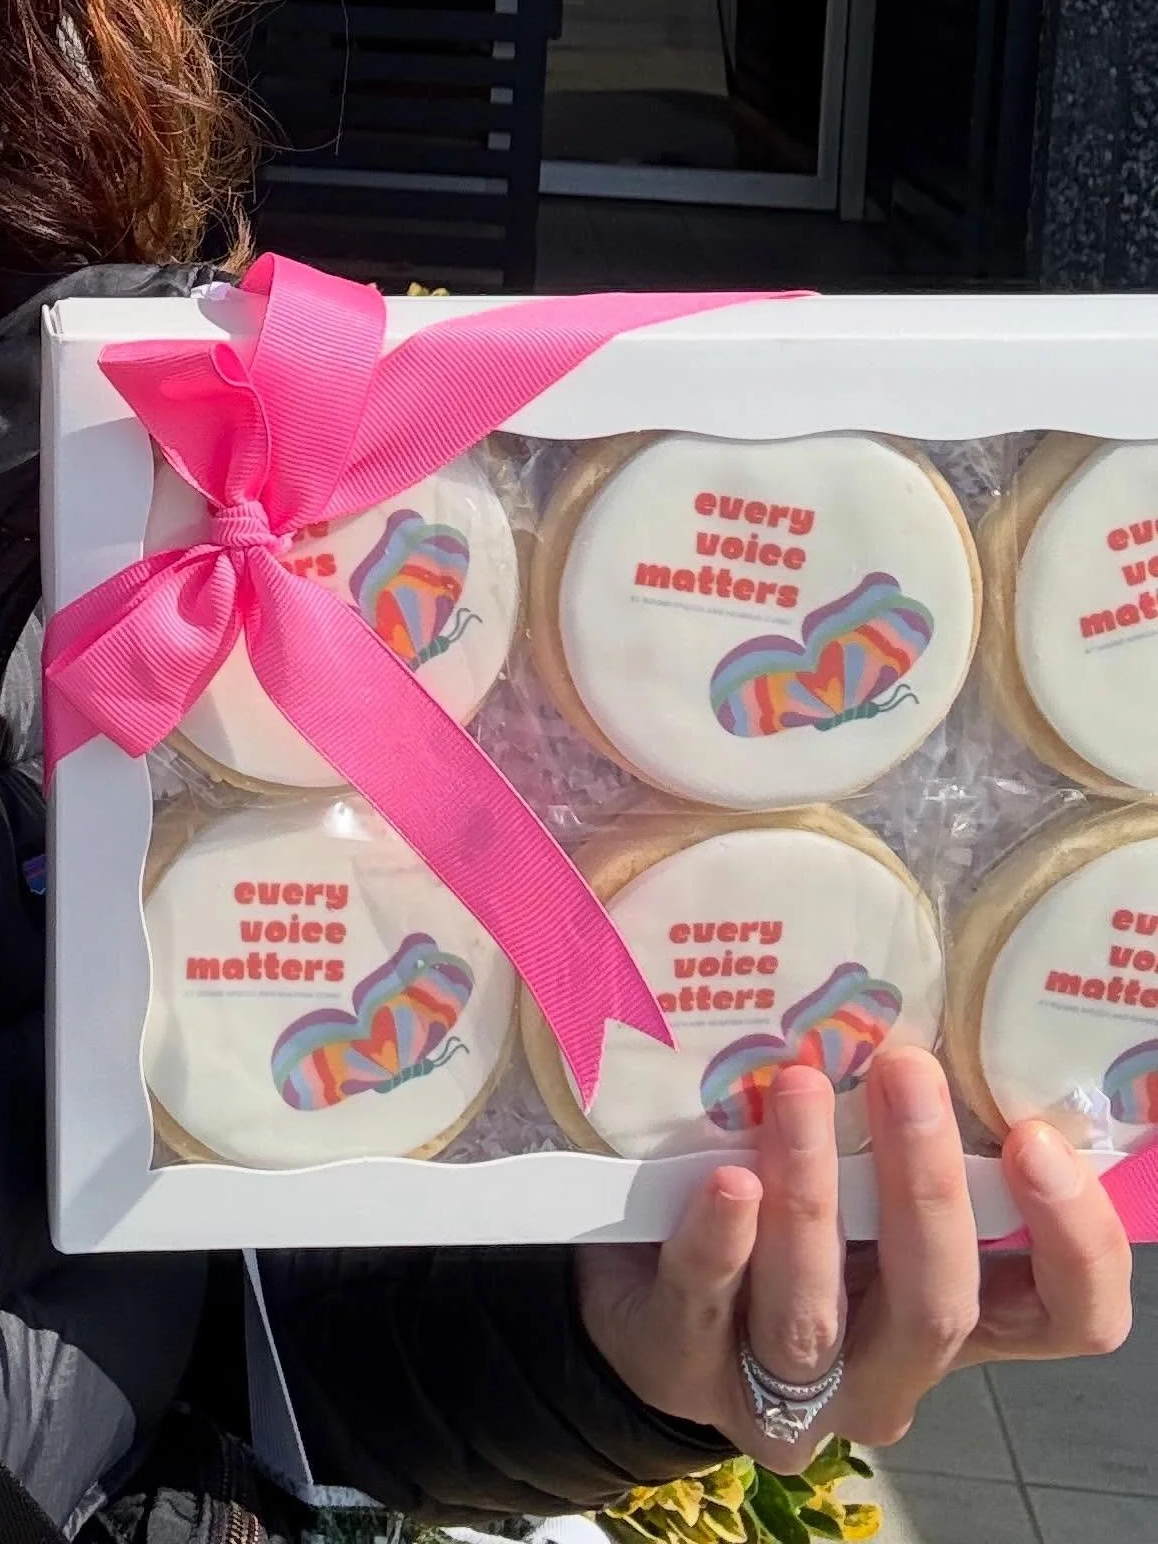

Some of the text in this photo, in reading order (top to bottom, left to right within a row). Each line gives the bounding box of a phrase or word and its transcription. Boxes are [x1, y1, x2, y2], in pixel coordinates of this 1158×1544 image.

[694, 492, 815, 536] every
[696, 531, 806, 570] voice
[634, 562, 799, 608] matters
[234, 881, 349, 911] every
[240, 914, 347, 944] voice
[669, 920, 783, 945] every
[185, 951, 345, 982] matters
[673, 950, 779, 978] voice
[657, 984, 775, 1013] atters
